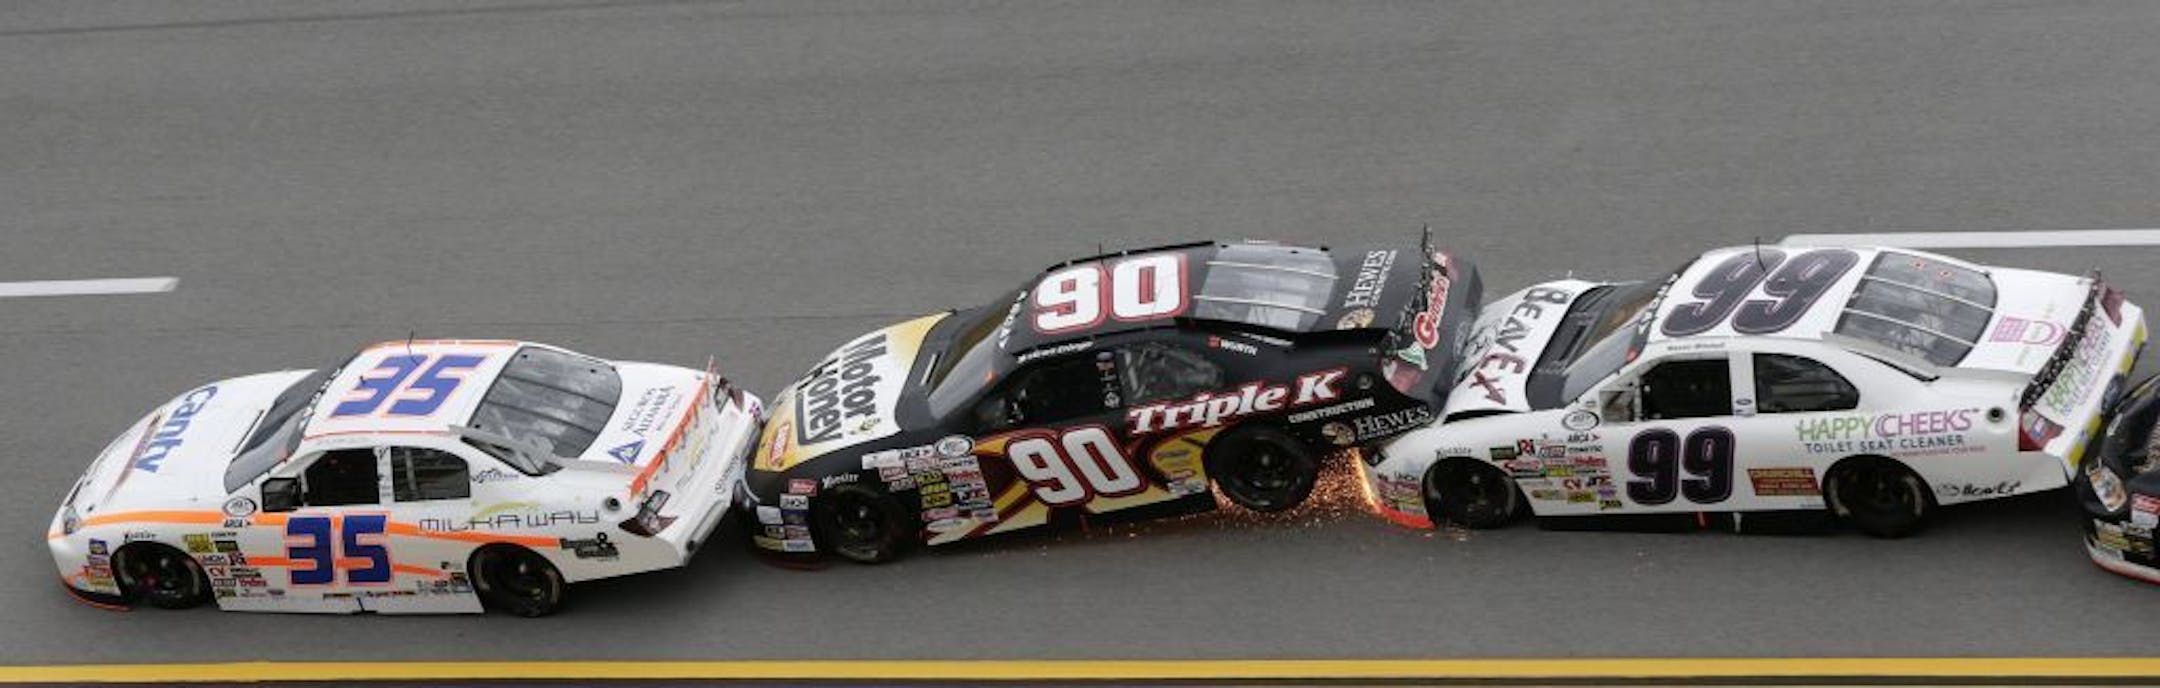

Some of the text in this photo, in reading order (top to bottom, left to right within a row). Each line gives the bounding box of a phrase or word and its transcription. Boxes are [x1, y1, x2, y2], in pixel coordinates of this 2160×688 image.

[1034, 253, 1188, 333] 90
[1344, 250, 1388, 307] HEWES
[1660, 248, 1860, 337] 99
[841, 333, 889, 419] Motor
[1468, 286, 1567, 406] BEAVEX
[331, 353, 488, 418] 35
[1128, 368, 1347, 435] Triple K
[1354, 404, 1430, 435] HEWES
[1797, 409, 1972, 442] HAPPY CHEEKS
[1805, 442, 1853, 454] TOILET
[1860, 439, 1894, 452] SEAT
[1900, 434, 1963, 450] CLEANER
[1009, 427, 1141, 505] 90
[1626, 426, 1735, 505] 99
[286, 513, 391, 587] 35
